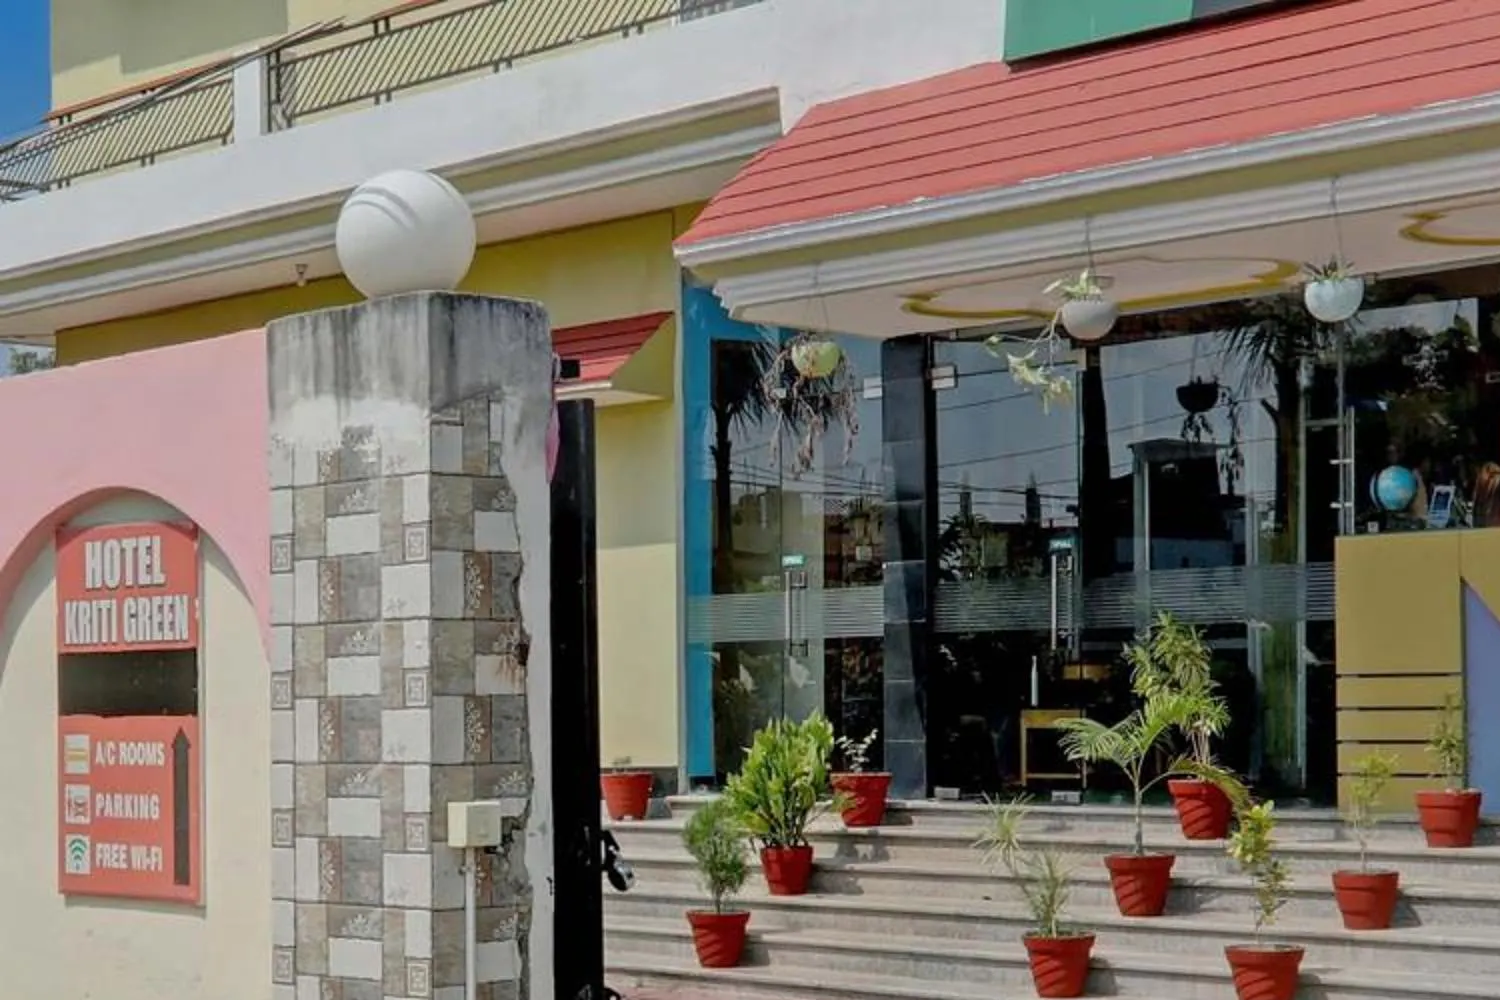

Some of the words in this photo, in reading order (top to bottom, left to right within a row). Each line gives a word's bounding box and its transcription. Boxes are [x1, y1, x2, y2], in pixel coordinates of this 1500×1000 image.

[84, 535, 166, 590] HOTEL
[64, 599, 119, 645] KRITI
[123, 594, 189, 643] GREEN
[119, 742, 165, 767] ROOMS
[95, 792, 160, 820] PARKING
[95, 843, 128, 869] FREE
[131, 845, 162, 871] WI-FI
